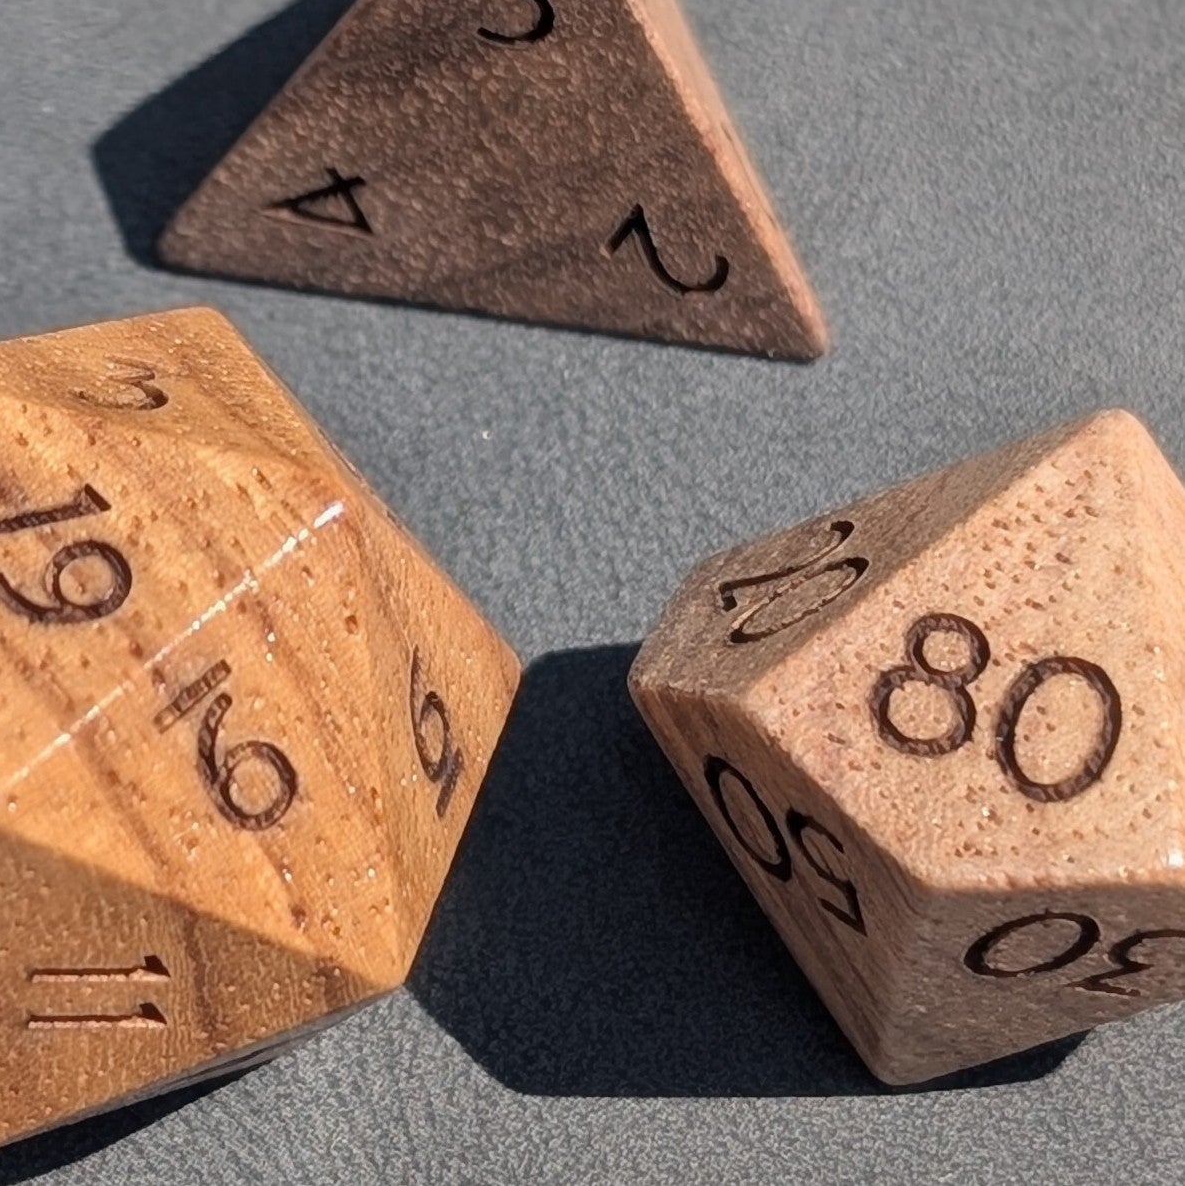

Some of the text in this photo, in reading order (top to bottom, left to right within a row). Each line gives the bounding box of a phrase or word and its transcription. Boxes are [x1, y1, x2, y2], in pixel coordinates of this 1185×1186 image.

[265, 166, 374, 235] 4
[606, 203, 730, 294] 2
[70, 354, 170, 411] 3
[718, 520, 871, 646] 20
[871, 614, 1123, 803] 80
[705, 755, 867, 937] 50
[27, 954, 170, 1030] 11
[963, 909, 1185, 998] 30
